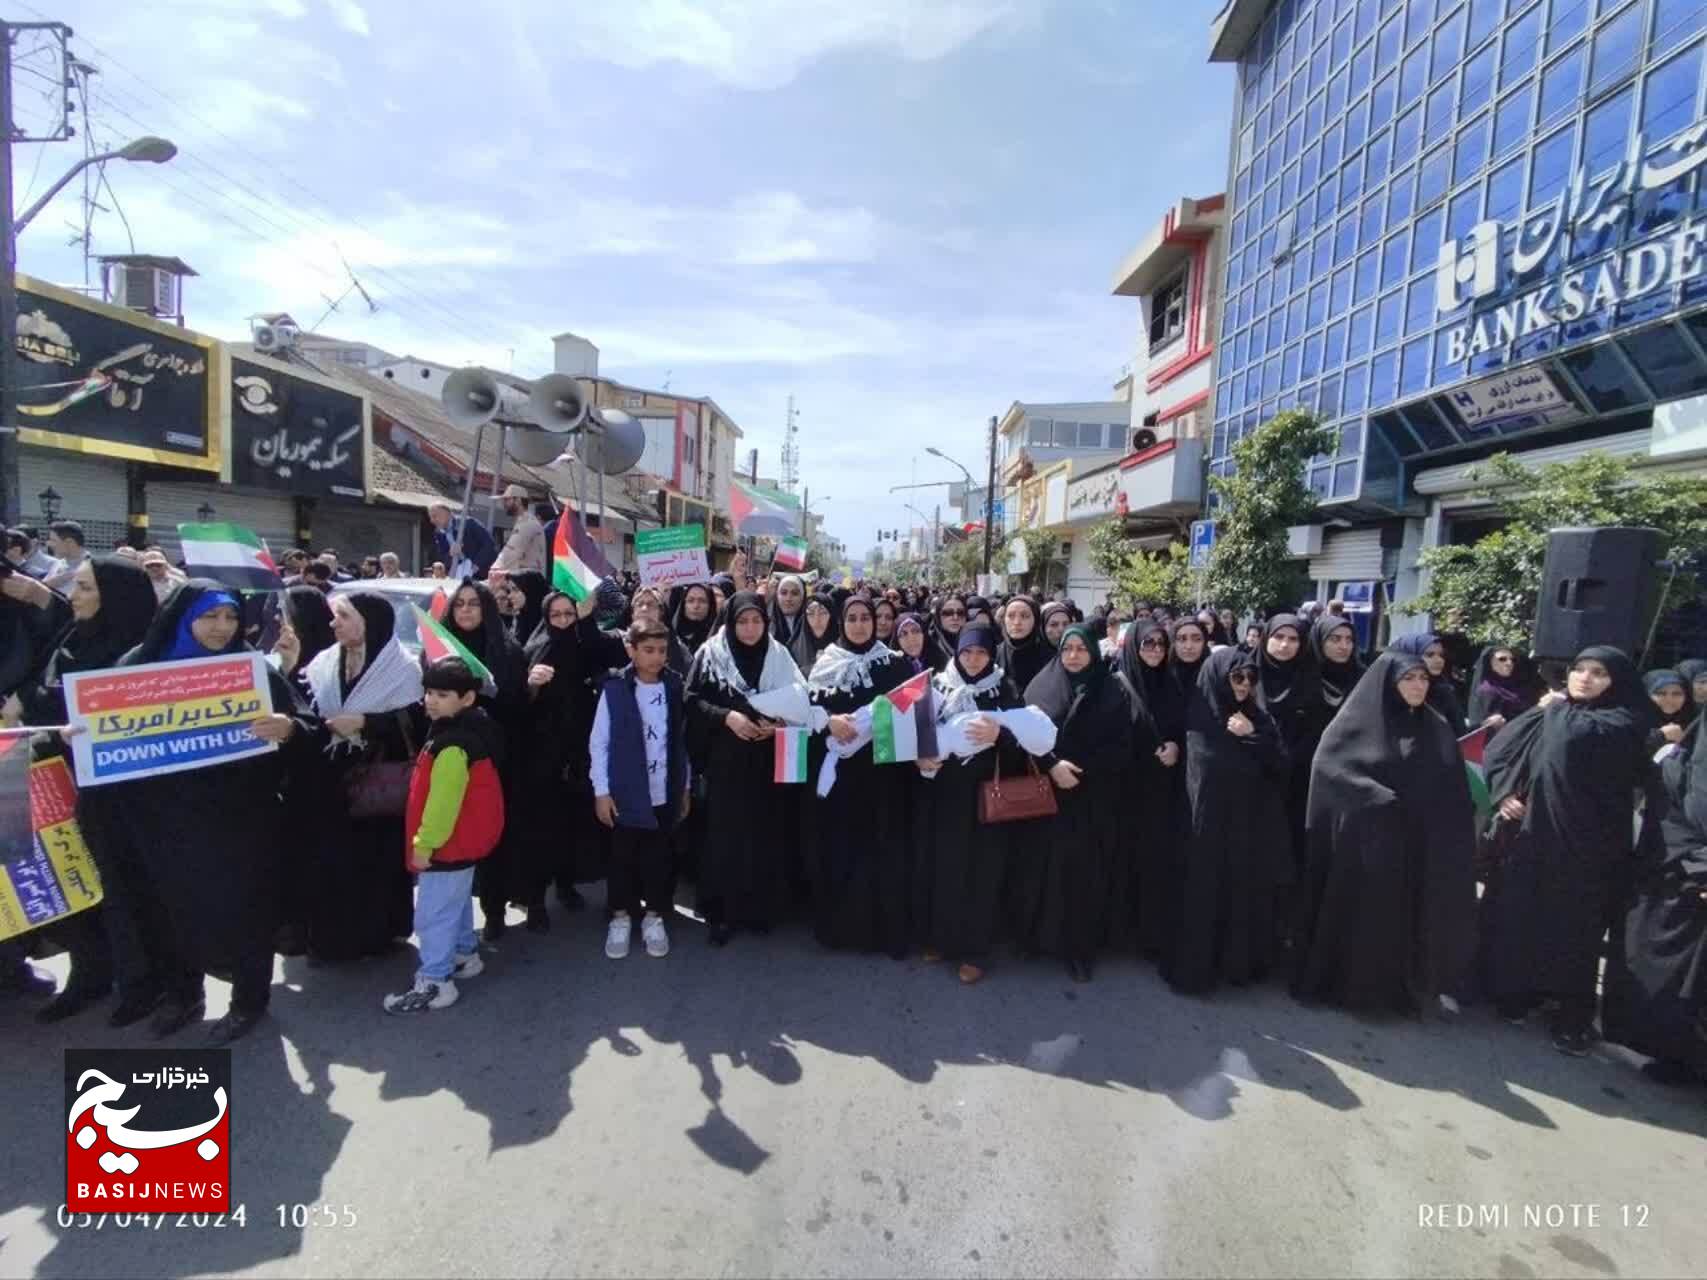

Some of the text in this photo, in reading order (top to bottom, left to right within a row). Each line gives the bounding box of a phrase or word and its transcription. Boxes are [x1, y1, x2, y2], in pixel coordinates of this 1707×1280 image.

[1446, 284, 1552, 366] BANK
[1195, 524, 1206, 545] P
[98, 698, 261, 737] مرگ بر آمریکا
[96, 728, 258, 767] DOWN WITH US
